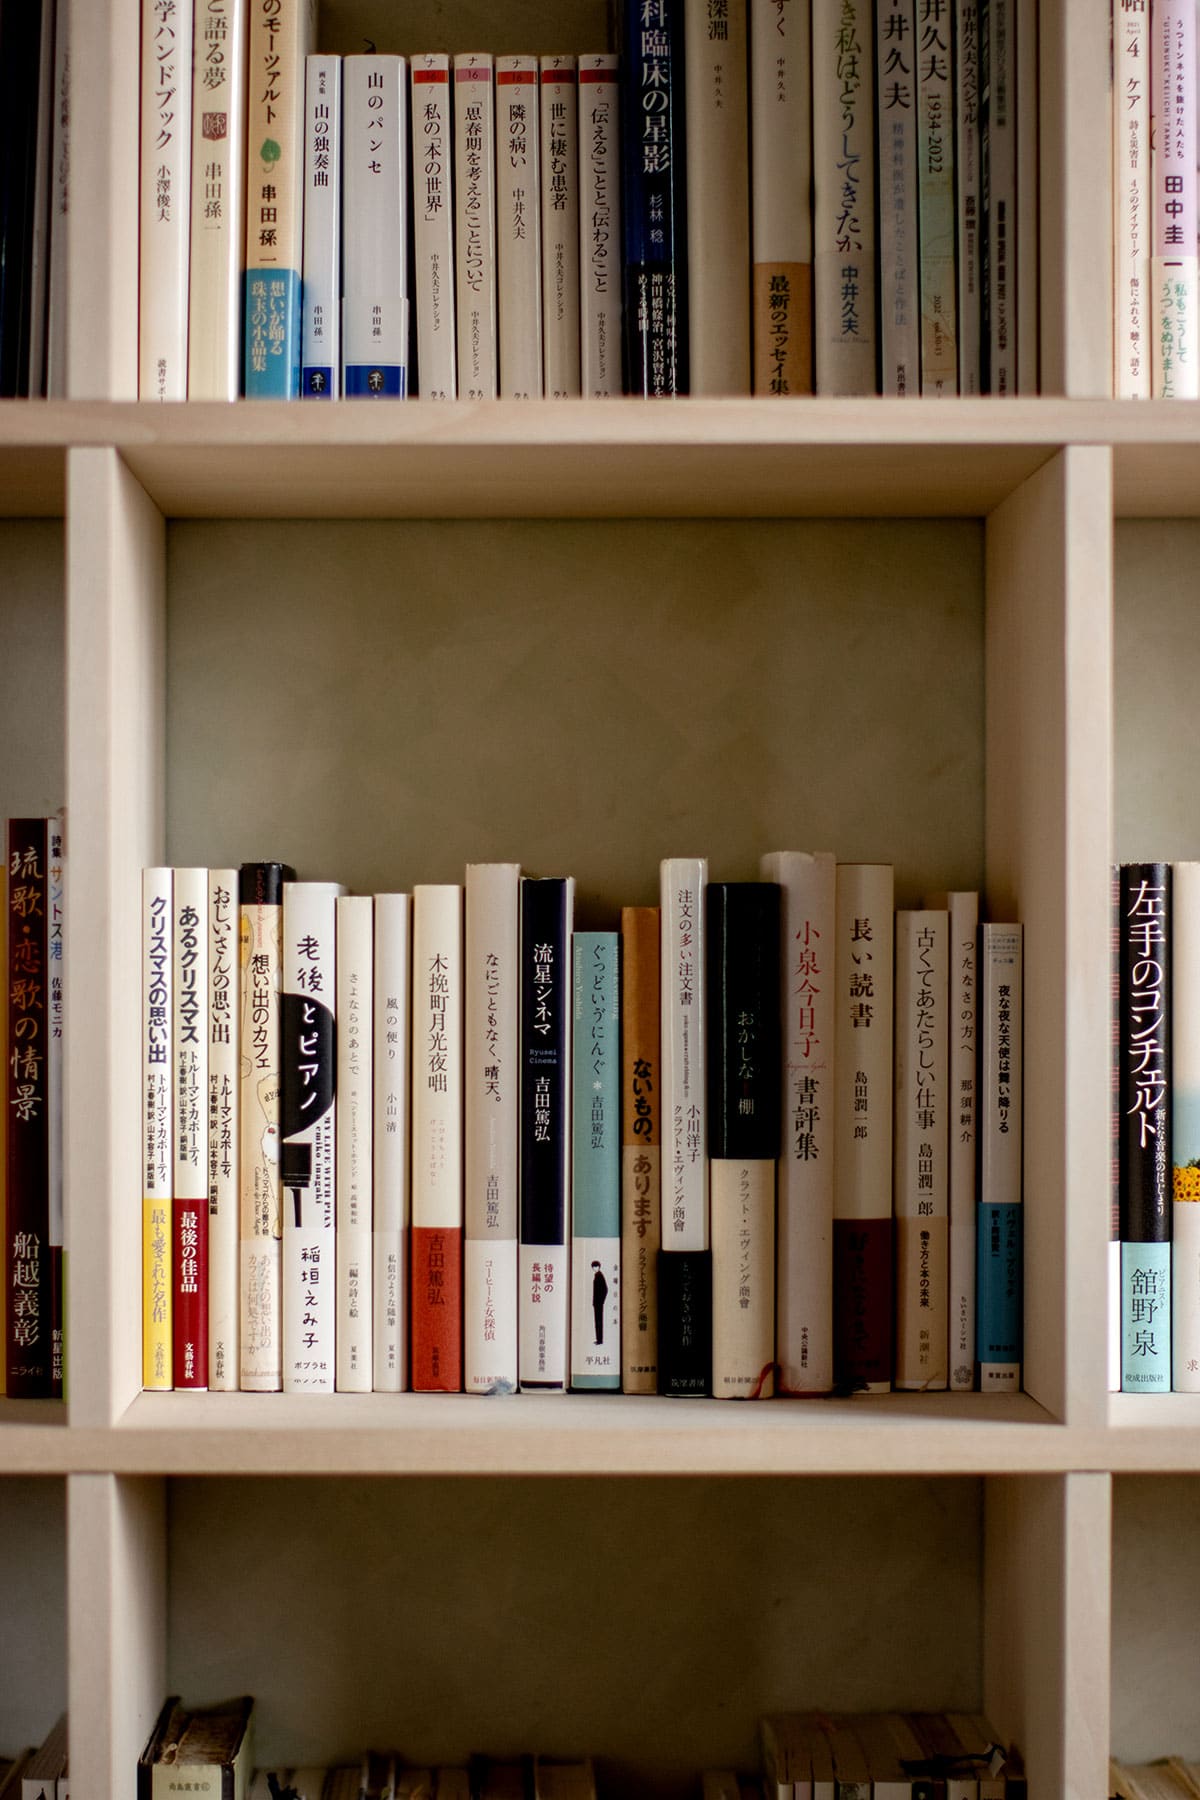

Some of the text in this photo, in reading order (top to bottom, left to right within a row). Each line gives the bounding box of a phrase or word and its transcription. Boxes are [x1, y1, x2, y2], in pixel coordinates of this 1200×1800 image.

[425, 58, 435, 68] ナ
[468, 57, 478, 66] ナ
[468, 71, 478, 79] 16
[512, 59, 522, 68] ナ
[553, 58, 562, 67] ナ
[1126, 37, 1140, 58] 4
[367, 72, 384, 174] 山のパンセ
[928, 93, 943, 174] 1934-2022
[1127, 78, 1141, 109] ケア
[313, 103, 329, 187] 山の独奏曲
[423, 103, 442, 221] 私の「本の世界」
[509, 104, 527, 168] 隣の病い
[550, 103, 568, 211] 世に棲む患者
[204, 162, 222, 231] 串田孫一
[259, 185, 278, 262] 串田孫一
[465, 101, 483, 292] 「思春期を考える」ことについて
[512, 188, 526, 240] 中井久夫
[592, 102, 610, 293] 「伝える」ことと「伝わる」こと
[1164, 176, 1184, 267] 田中圭一
[769, 275, 790, 395] 最新のエッセイ集
[841, 266, 859, 335] 中井久夫
[10, 846, 44, 1121] 琉歌・恋歌の情景
[148, 896, 168, 1064] クリスマスの思い出
[179, 905, 200, 1044] あるクリスマス
[211, 886, 231, 1045] おじいさんの思い出
[678, 888, 693, 1006] 注文の多い注文書
[850, 918, 874, 1029] 長い読書
[51, 977, 63, 1039] 佐藤モニカ
[251, 953, 271, 1069] 想い出のカフェ
[297, 935, 325, 1110] 老後とピアノ
[386, 997, 398, 1060] 風の便り
[428, 953, 449, 1093] 木挽町月光夜咄
[484, 953, 501, 1102] なにごともなく、晴天。
[533, 943, 554, 1035] 流星シネマ
[794, 920, 822, 1059] 小泉今日子
[915, 926, 936, 1130] 古くてあたらしい仕事
[960, 940, 974, 1052] つたなさの方へ
[1127, 879, 1167, 1149] 左手のコンチェルト
[998, 984, 1011, 1134] 夜な夜な天使は舞い降りる
[534, 1076, 550, 1142] 吉田篤弘
[591, 1095, 604, 1150] 吉田篤弘
[687, 1104, 701, 1163] 小川洋子
[792, 1076, 820, 1162] 書評集
[853, 1070, 868, 1140] 島田潤一郎
[960, 1079, 973, 1143] 那須耕介
[315, 1163, 323, 1204] inagaki
[486, 1175, 499, 1228] 吉田篤弘
[918, 1143, 934, 1217] 島田潤一郎
[13, 1231, 40, 1348] 船越義彰
[151, 1209, 167, 1324] 最も愛された名作
[180, 1211, 198, 1294] 最後の佳品
[426, 1234, 445, 1306] 吉田篤弘
[531, 1263, 541, 1304] 長編小説
[544, 1263, 554, 1293] 待望の
[301, 1246, 320, 1348] 稲垣えみ子
[484, 1260, 496, 1342] コーヒーと女探偵
[184, 1341, 194, 1379] 文藝春秋
[585, 1356, 610, 1366] 平凡社
